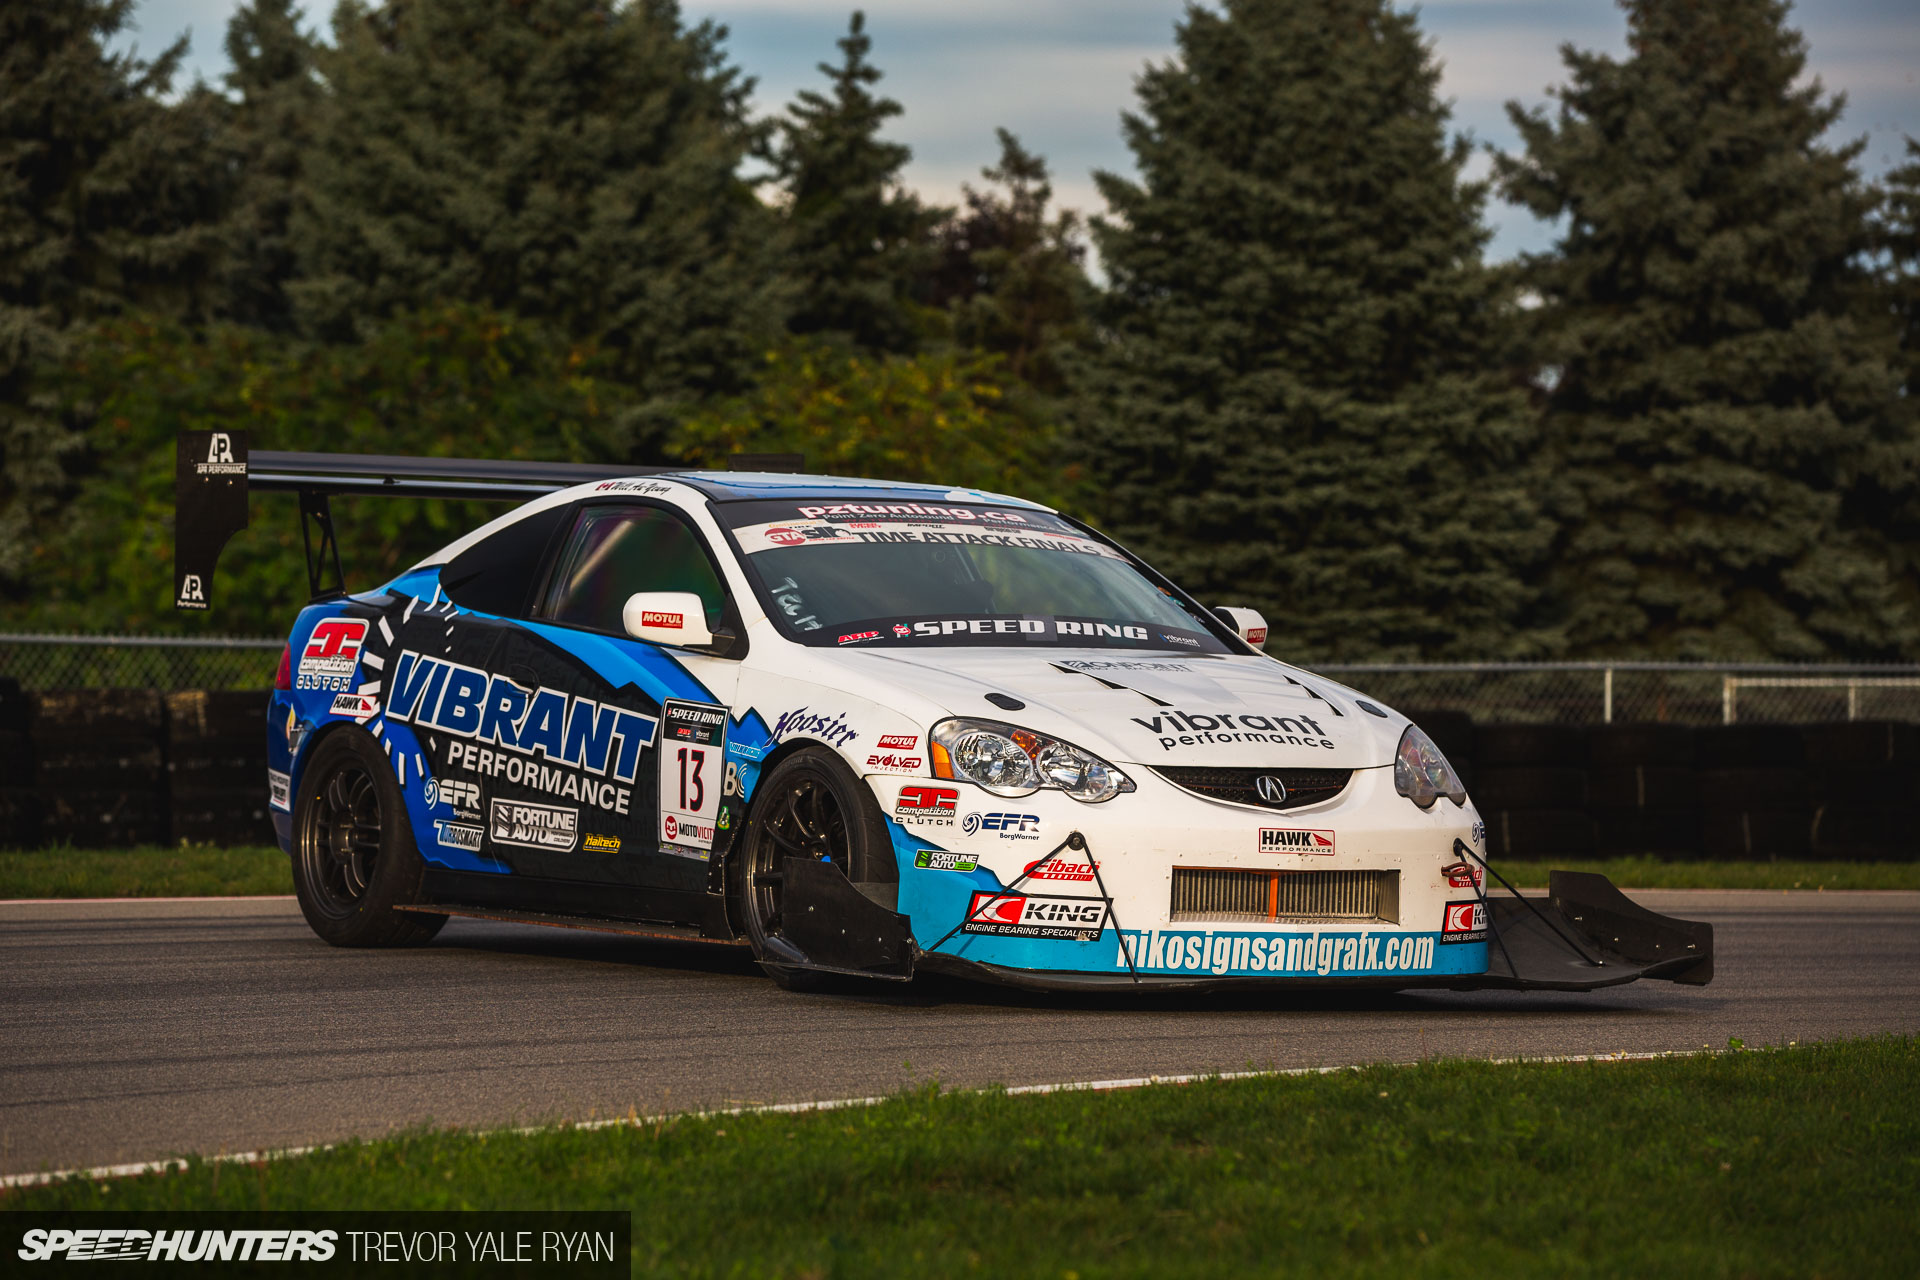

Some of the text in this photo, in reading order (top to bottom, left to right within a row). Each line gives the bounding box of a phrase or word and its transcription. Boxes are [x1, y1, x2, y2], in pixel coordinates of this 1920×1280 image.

[209, 465, 246, 474] PERFORMANCE
[797, 503, 1027, 523] pztuning.ca
[890, 513, 955, 522] Autosound
[767, 531, 805, 542] GTA
[851, 531, 922, 543] TIME
[920, 531, 1014, 547] ATTACK
[1018, 537, 1102, 556] FINALS
[643, 613, 682, 624] MOTUL
[838, 630, 880, 643] ARP
[914, 619, 1148, 640] SPEED RING
[1164, 634, 1199, 645] vibrant
[301, 655, 356, 675] competition
[296, 676, 351, 691] CLUTCH
[333, 695, 361, 711] HAWK
[385, 649, 660, 785] VIBRANT
[671, 708, 724, 725] SPEED RING
[1130, 711, 1326, 737] vibrant
[762, 706, 856, 748] Hoosier
[880, 736, 916, 746] MOTUL
[1159, 731, 1335, 751] performance
[447, 741, 632, 816] PERFORMANCE
[677, 747, 705, 812] 13
[439, 779, 481, 810] EFR
[453, 808, 481, 819] BorgWarner
[513, 807, 575, 831] FORTUNE
[896, 806, 955, 818] competition
[895, 817, 954, 827] CLUTCH
[982, 813, 1040, 833] EFR
[434, 819, 485, 850] TURBOSMART
[512, 824, 548, 844] AUTO
[585, 834, 621, 849] Haltech
[999, 833, 1040, 841] BorgWarner
[1262, 831, 1312, 846] HAWK
[929, 860, 956, 869] AUTO
[931, 852, 978, 862] FORTUNE
[1025, 904, 1102, 923] KING
[965, 923, 1099, 938] ENGINE BEARING SPECIALISTS
[1442, 933, 1462, 942] ENGINE
[1463, 931, 1480, 941] BEARING
[1116, 930, 1435, 976] nikosignsandgrafx.com
